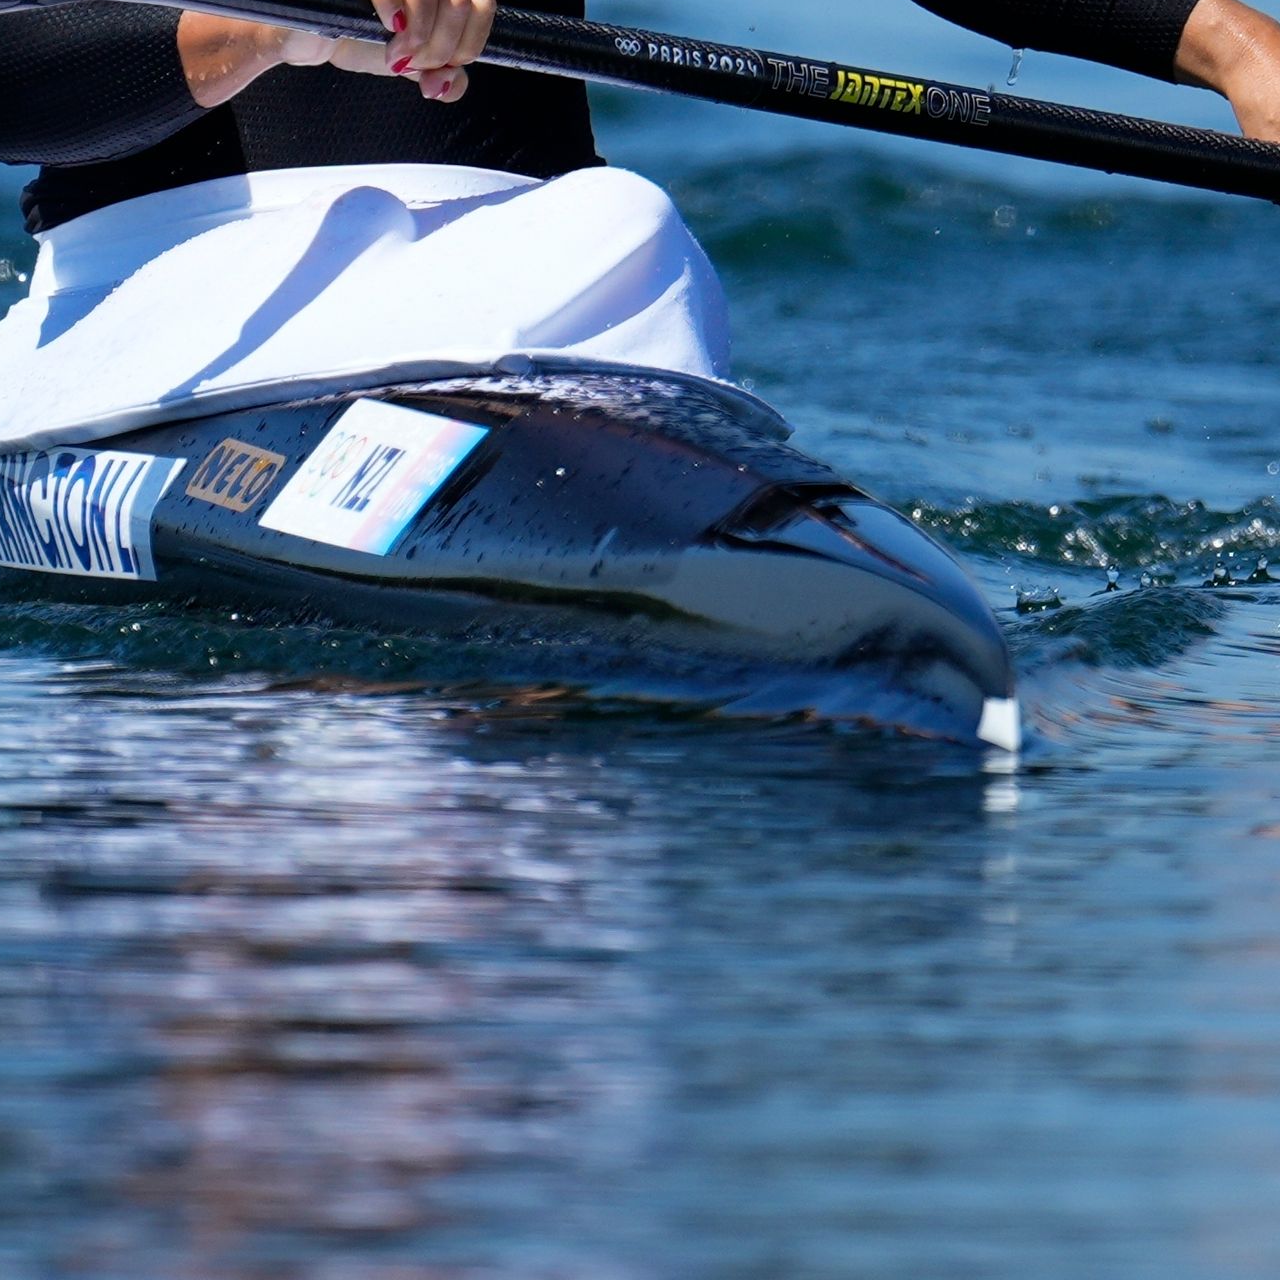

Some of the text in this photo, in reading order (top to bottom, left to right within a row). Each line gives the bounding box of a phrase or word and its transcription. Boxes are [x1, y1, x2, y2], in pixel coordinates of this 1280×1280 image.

[648, 42, 758, 78] PARIS 2024
[767, 58, 992, 126] THE JANTEX ONE
[191, 445, 278, 504] NELO
[329, 444, 407, 511] NZL
